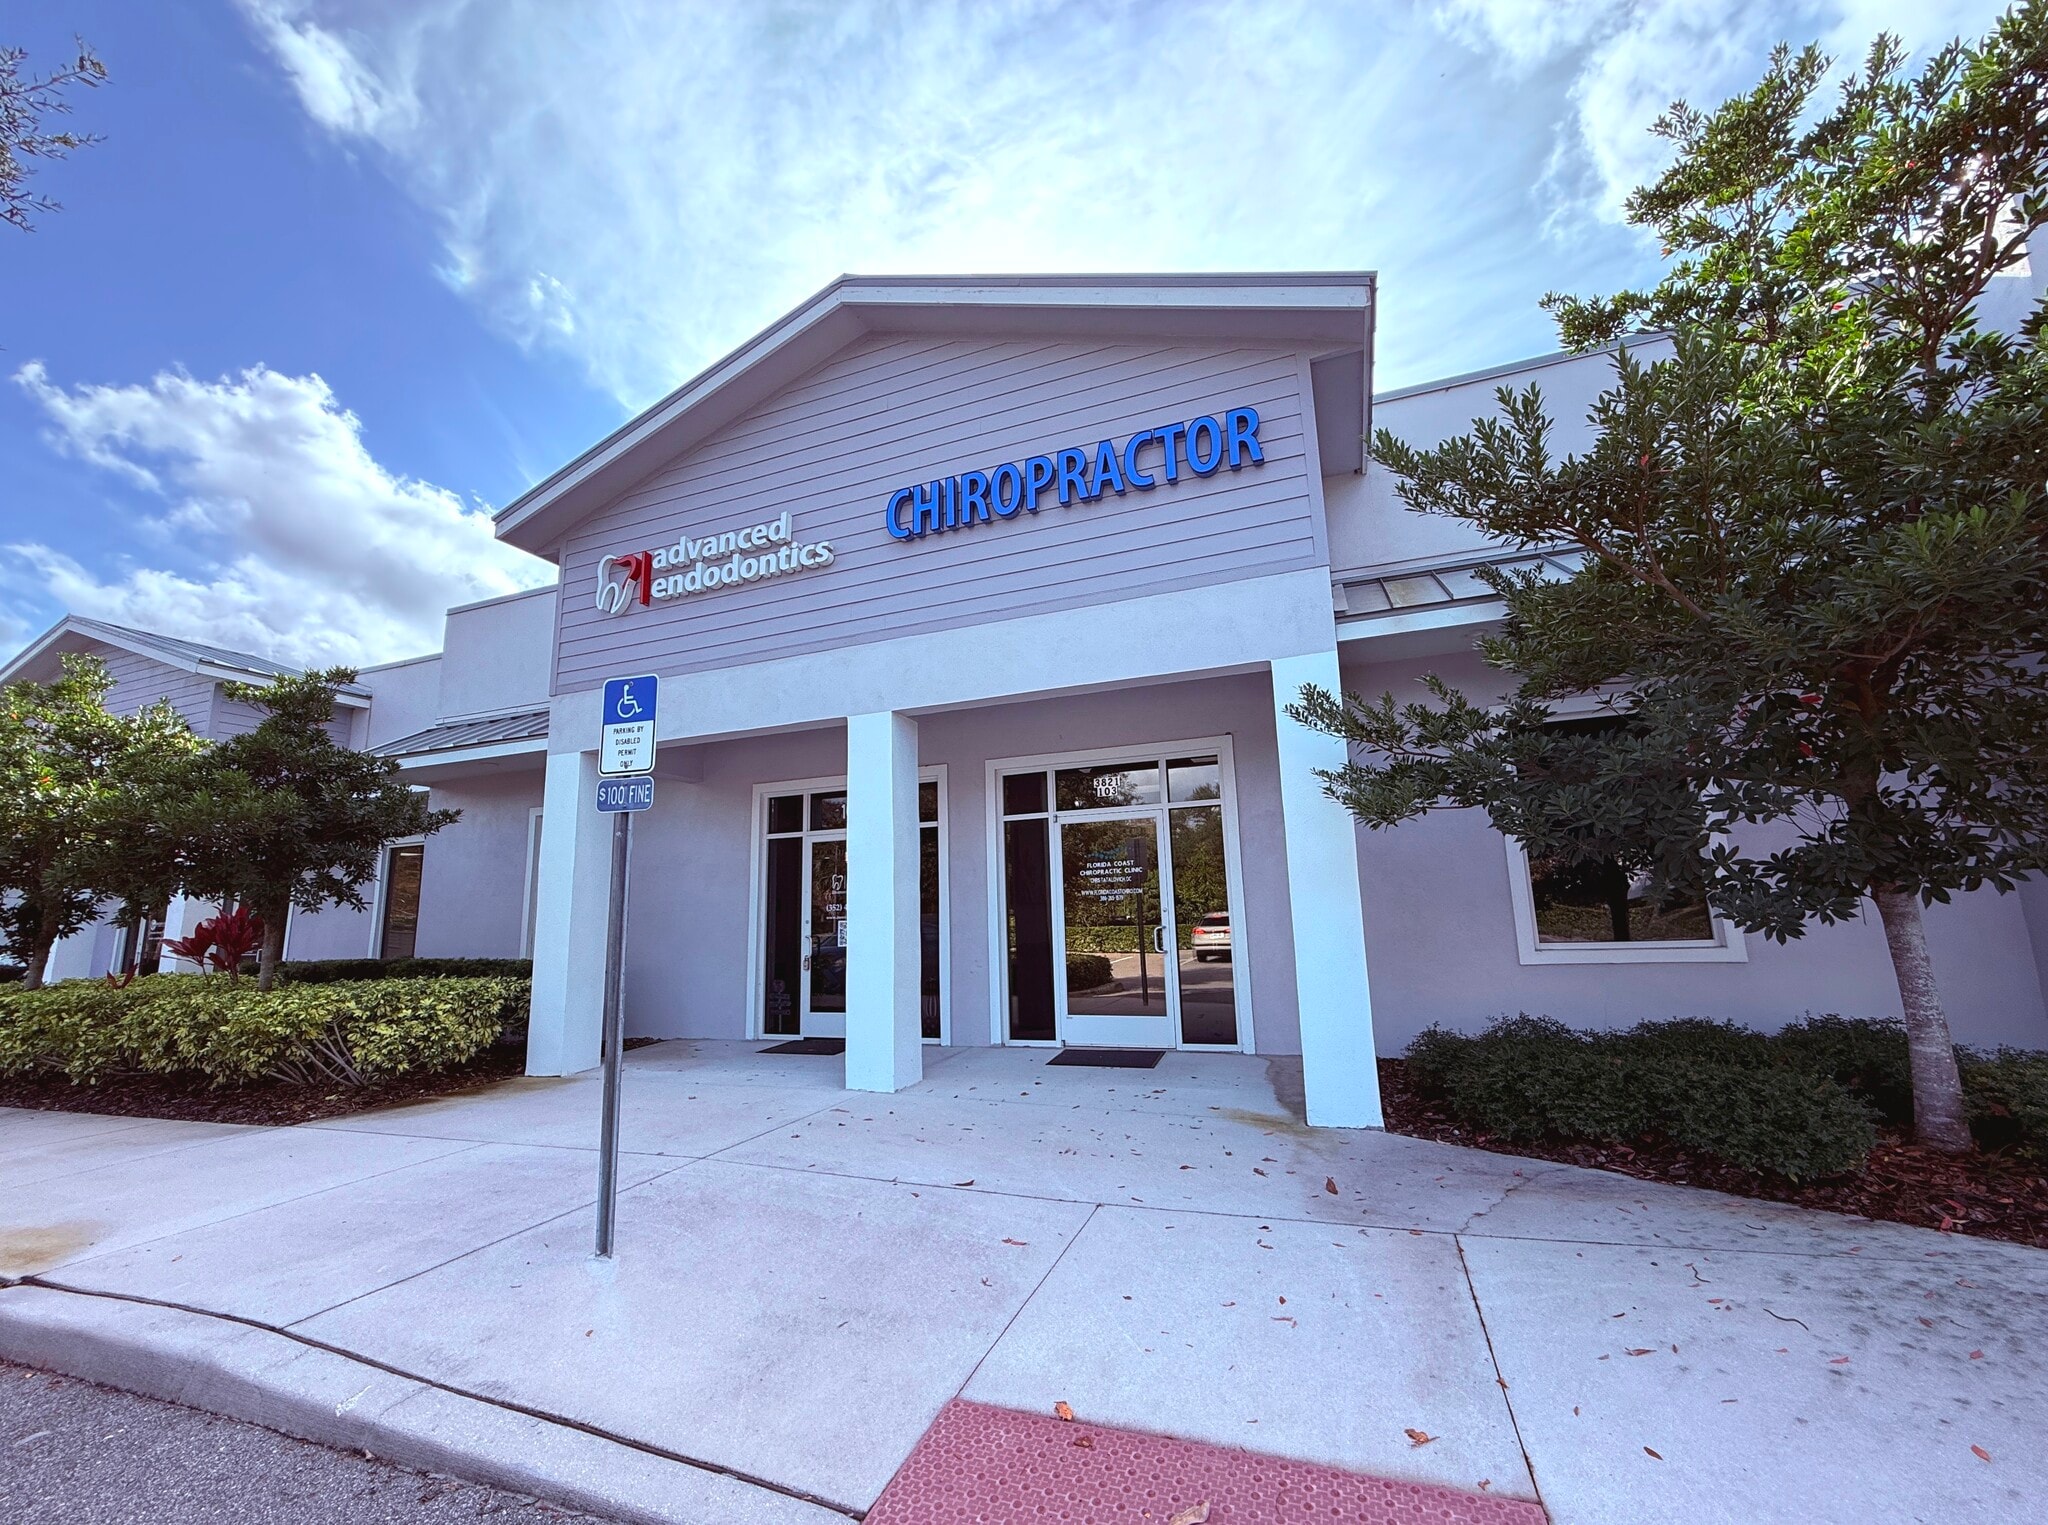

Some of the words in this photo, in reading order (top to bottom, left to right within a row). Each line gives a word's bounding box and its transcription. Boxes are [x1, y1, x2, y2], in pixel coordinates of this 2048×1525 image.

[886, 407, 1264, 541] CHIROPRACTOR
[652, 511, 792, 571] advanced
[651, 541, 834, 599] endodontics
[614, 727, 635, 735] PARKING
[616, 737, 640, 745] DISABLED
[618, 748, 636, 756] PERMIT
[620, 760, 633, 768] ONLY
[1095, 778, 1119, 788] 3821
[599, 786, 624, 804] $100
[629, 784, 650, 804] FINE
[1098, 787, 1117, 797] 103
[1080, 868, 1122, 876] CHIROPRACTIC
